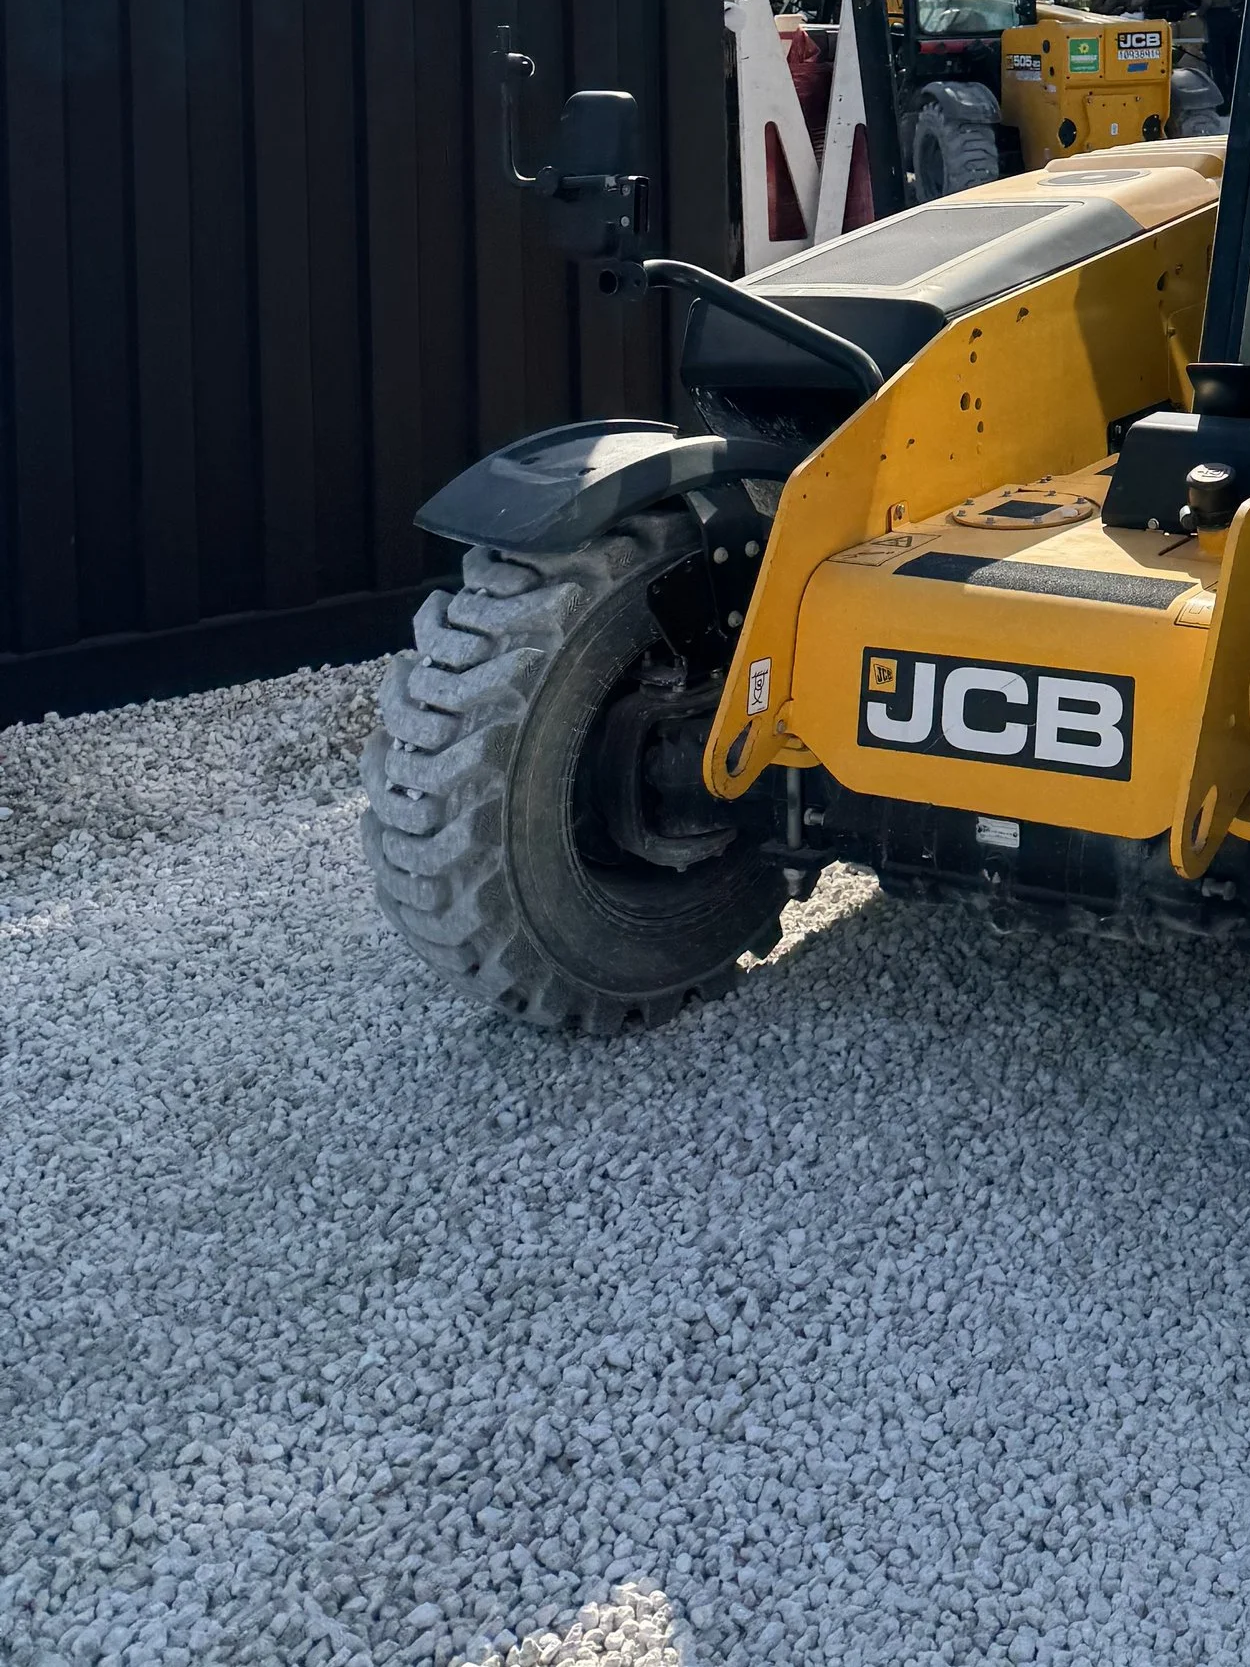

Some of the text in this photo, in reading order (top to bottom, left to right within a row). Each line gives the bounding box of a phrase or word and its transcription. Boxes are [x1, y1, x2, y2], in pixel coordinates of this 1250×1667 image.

[1120, 33, 1161, 48] JCB
[877, 666, 892, 682] JCB
[867, 662, 1124, 768] JCB
